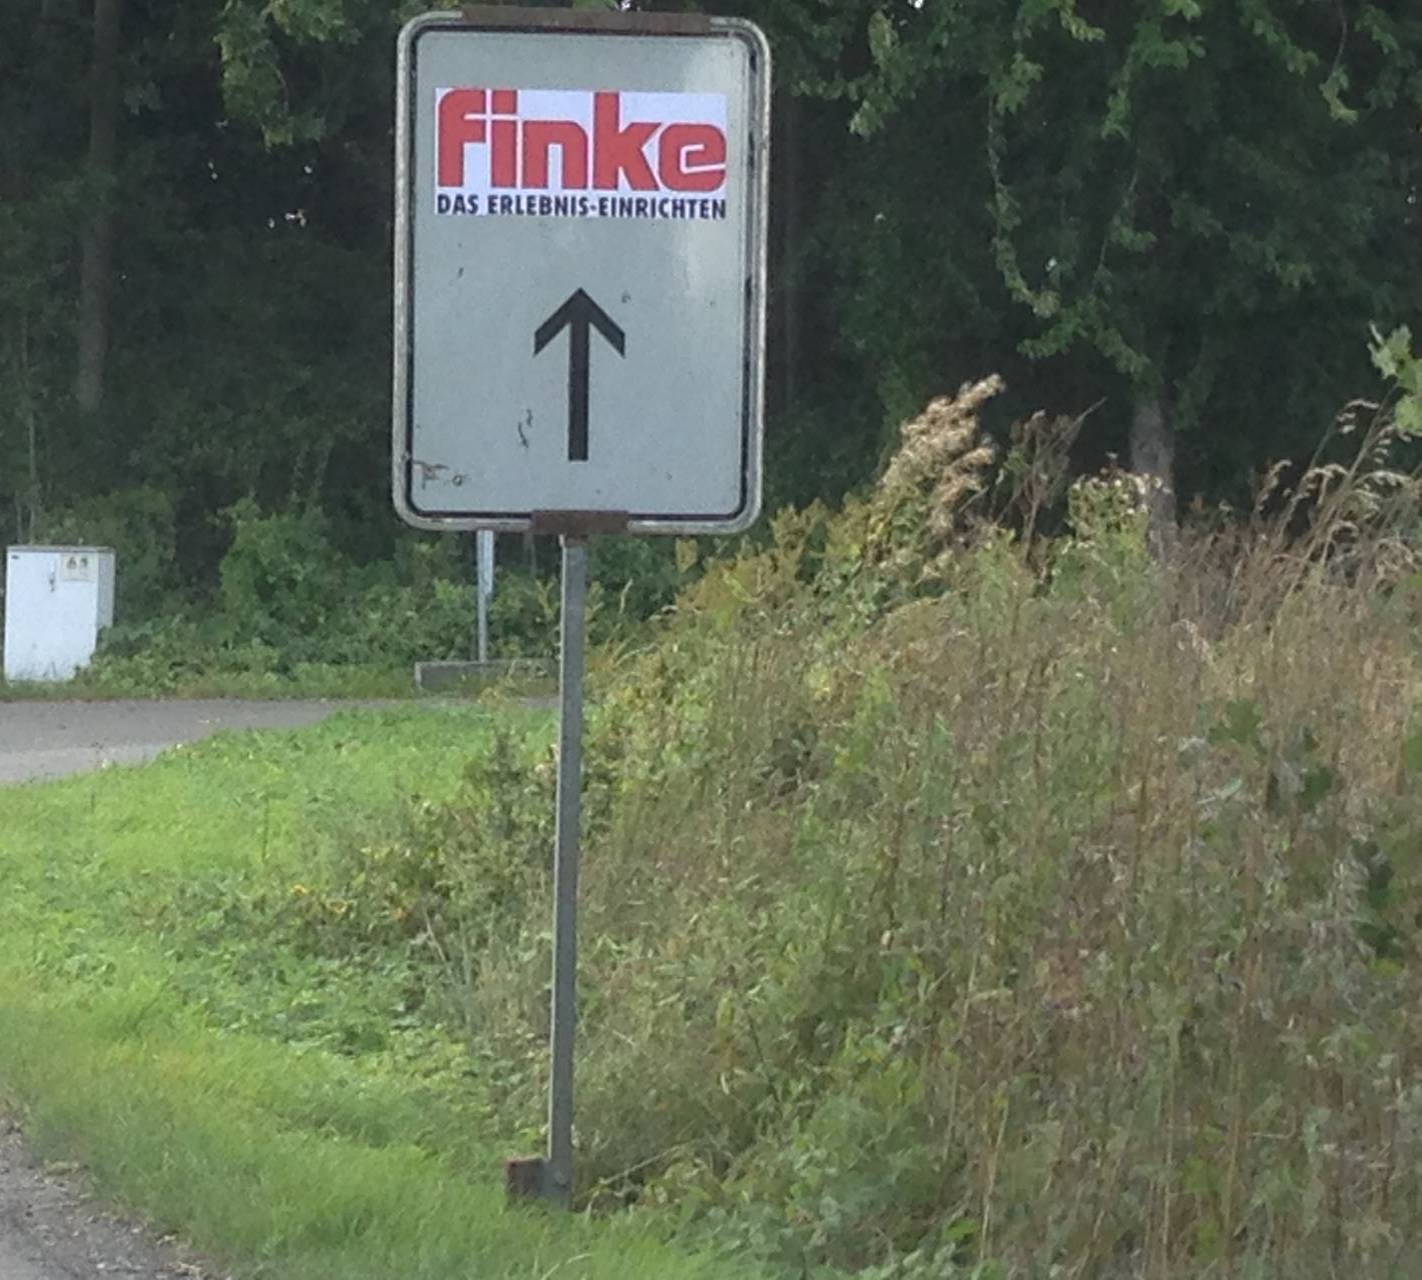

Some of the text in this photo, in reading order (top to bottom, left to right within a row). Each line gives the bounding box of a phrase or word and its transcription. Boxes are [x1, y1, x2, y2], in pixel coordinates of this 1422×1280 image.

[438, 88, 727, 192] finke
[437, 194, 727, 219] DAS ERLEBNIS-EINRICHTEN
